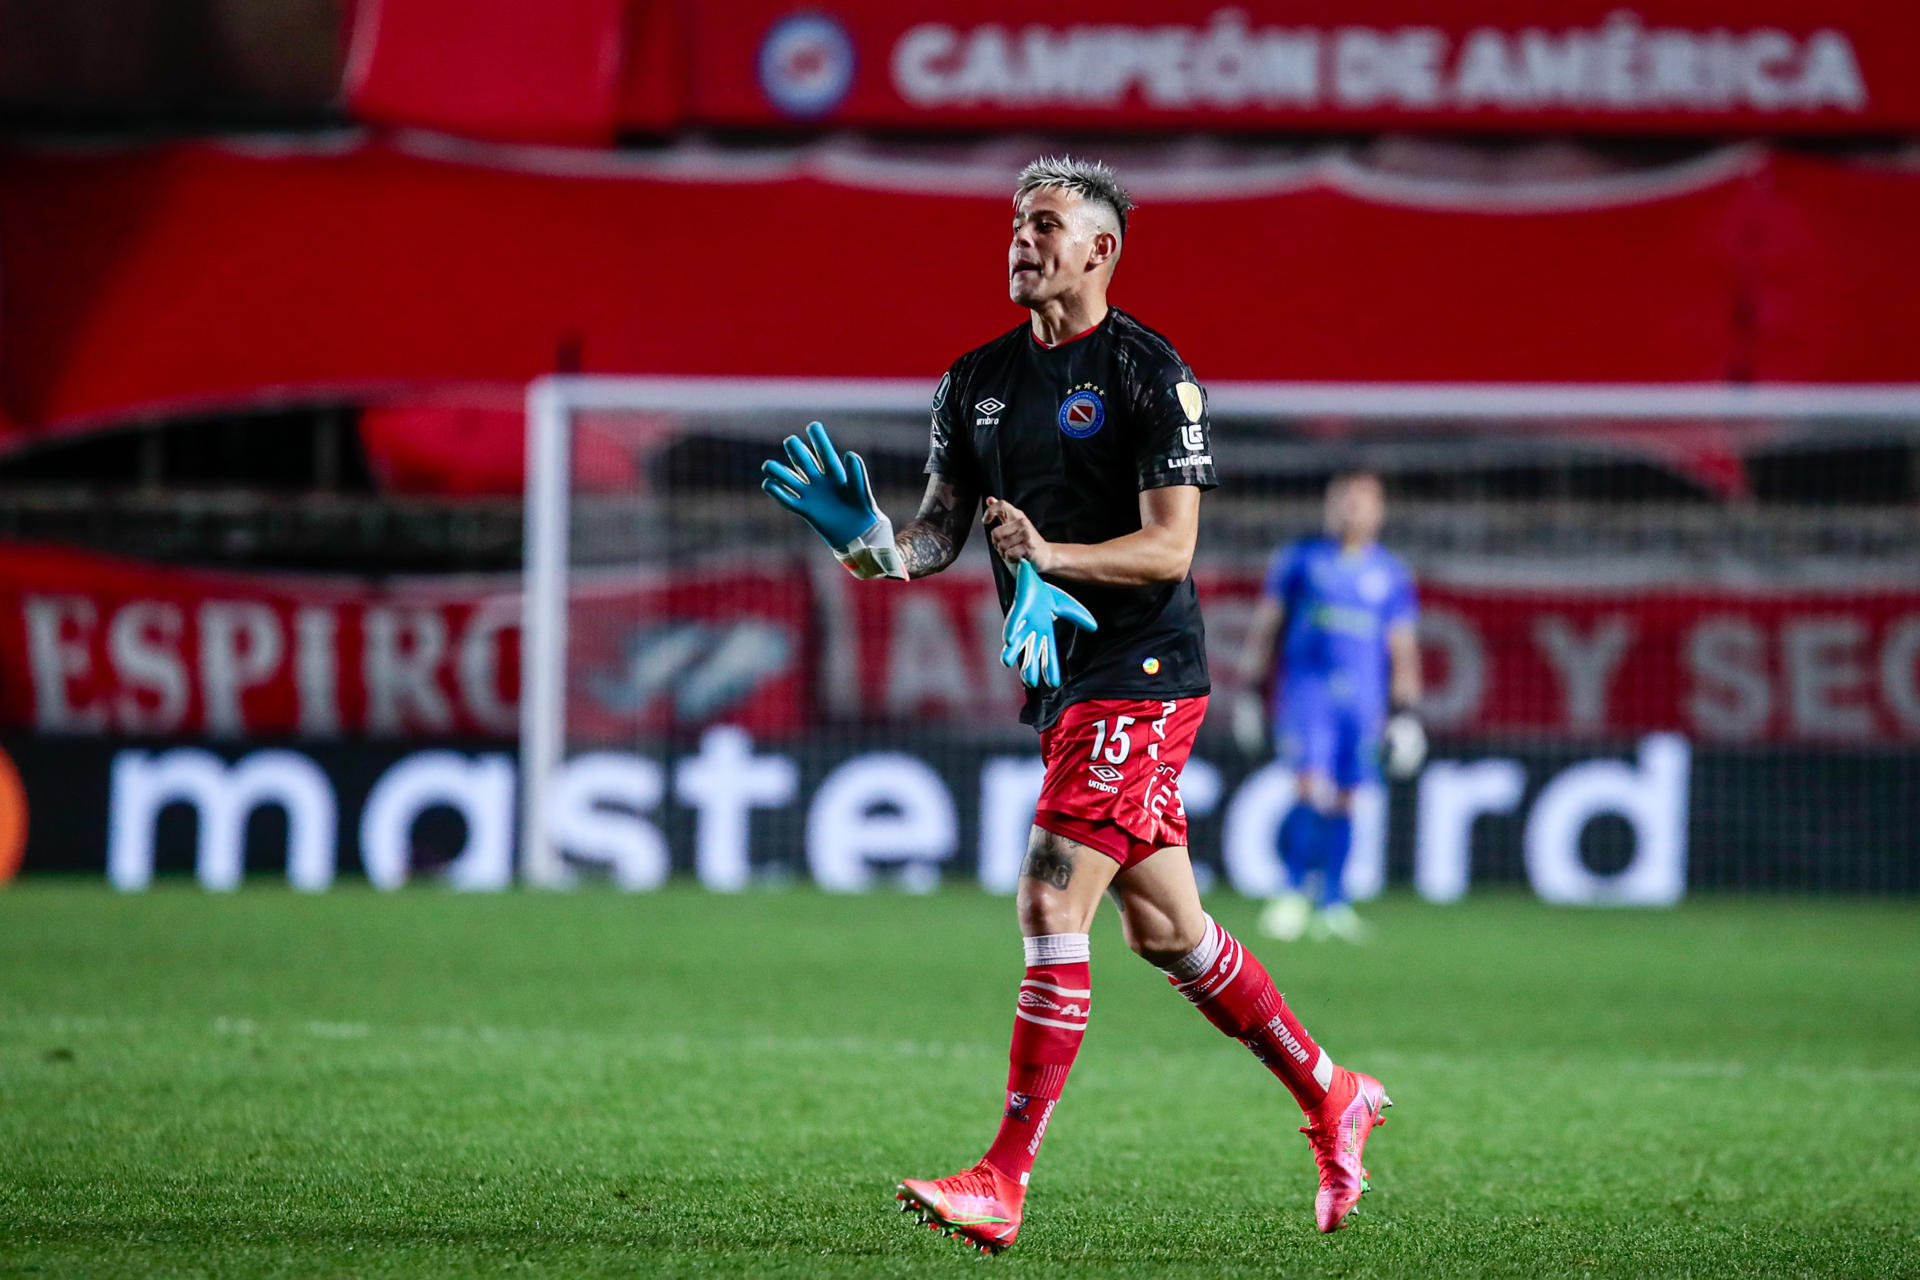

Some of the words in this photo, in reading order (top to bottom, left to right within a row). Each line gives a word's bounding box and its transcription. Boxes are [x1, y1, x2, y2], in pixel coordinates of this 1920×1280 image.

[890, 10, 1322, 106] CAMPEÓN
[1331, 28, 1450, 108] DE
[1456, 12, 1867, 111] AMÉRICA
[976, 415, 1000, 427] umbro
[1090, 715, 1136, 765] 15
[1088, 778, 1119, 795] umbro
